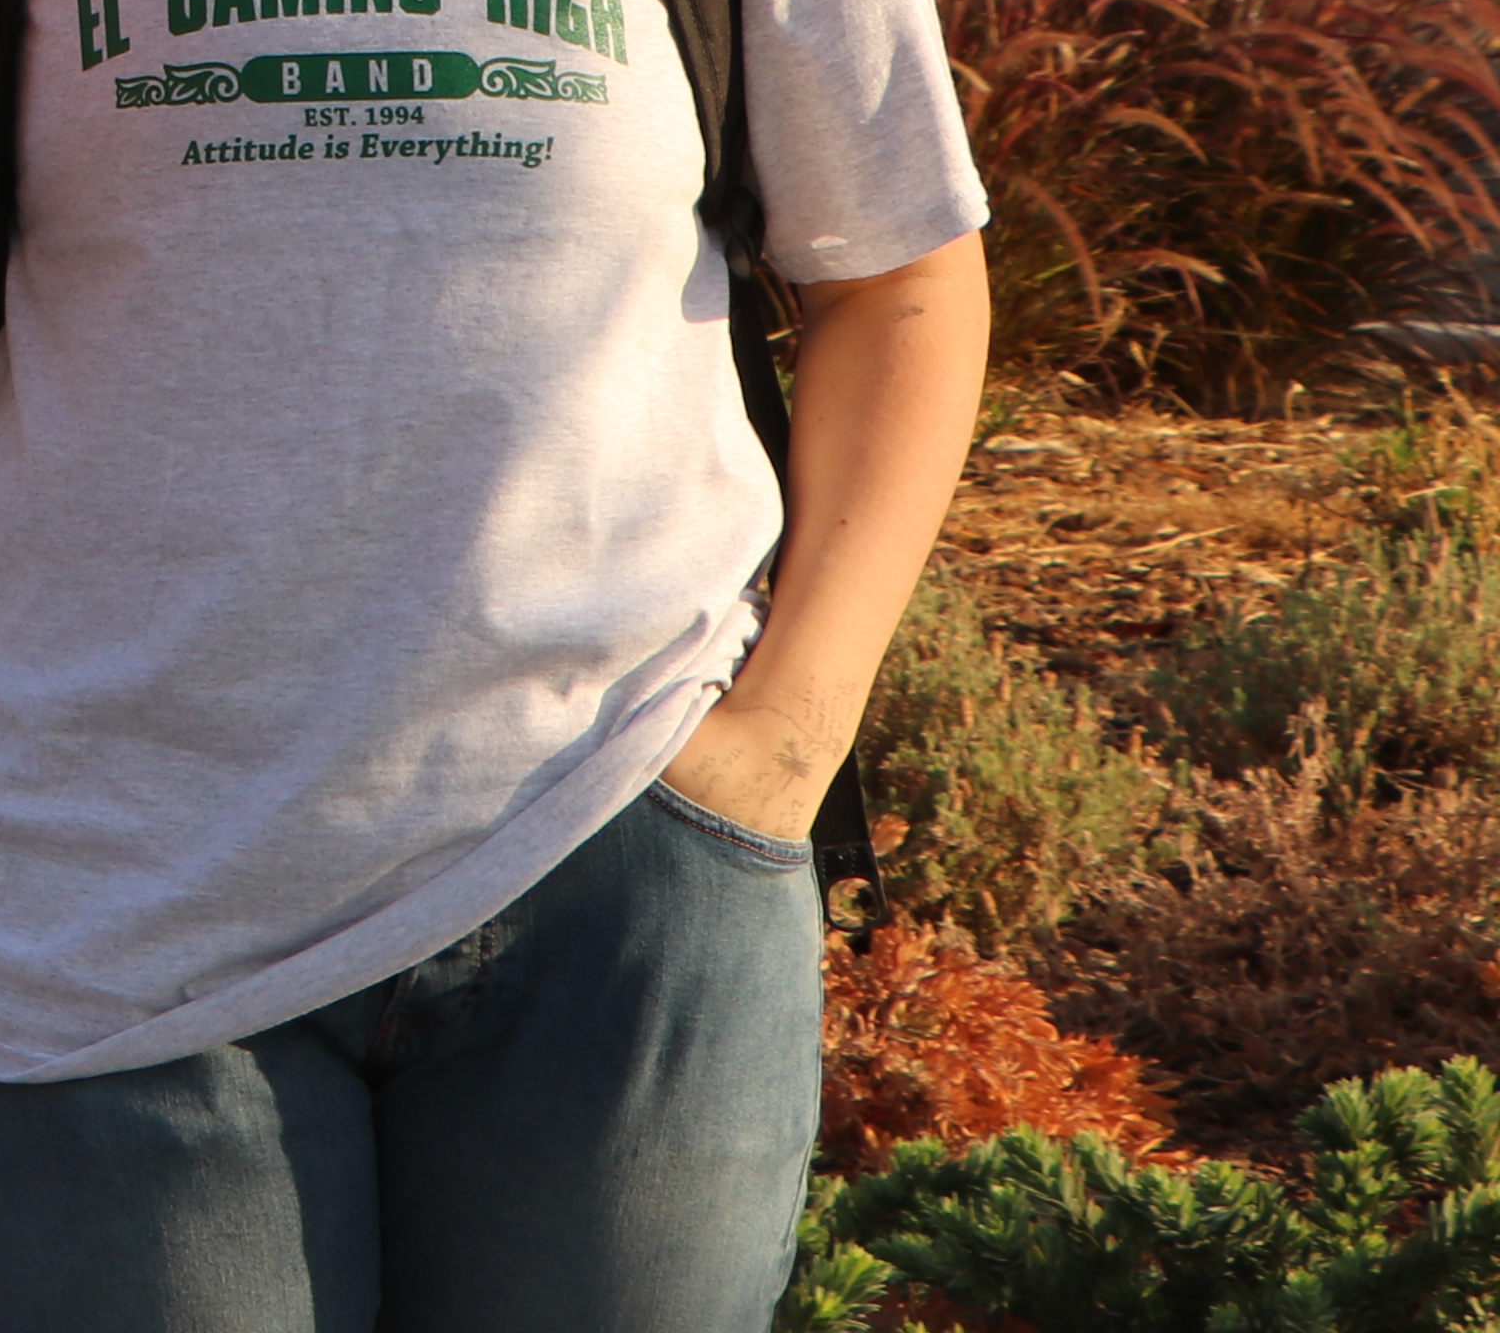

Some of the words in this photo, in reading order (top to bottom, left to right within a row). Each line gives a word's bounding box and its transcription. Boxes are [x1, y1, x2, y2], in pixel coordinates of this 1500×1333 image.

[282, 59, 433, 96] BAND
[304, 108, 357, 127] EST.
[366, 106, 425, 126] 1994
[181, 134, 315, 165] Attitude
[323, 134, 350, 159] is
[359, 131, 554, 168] Everything!
